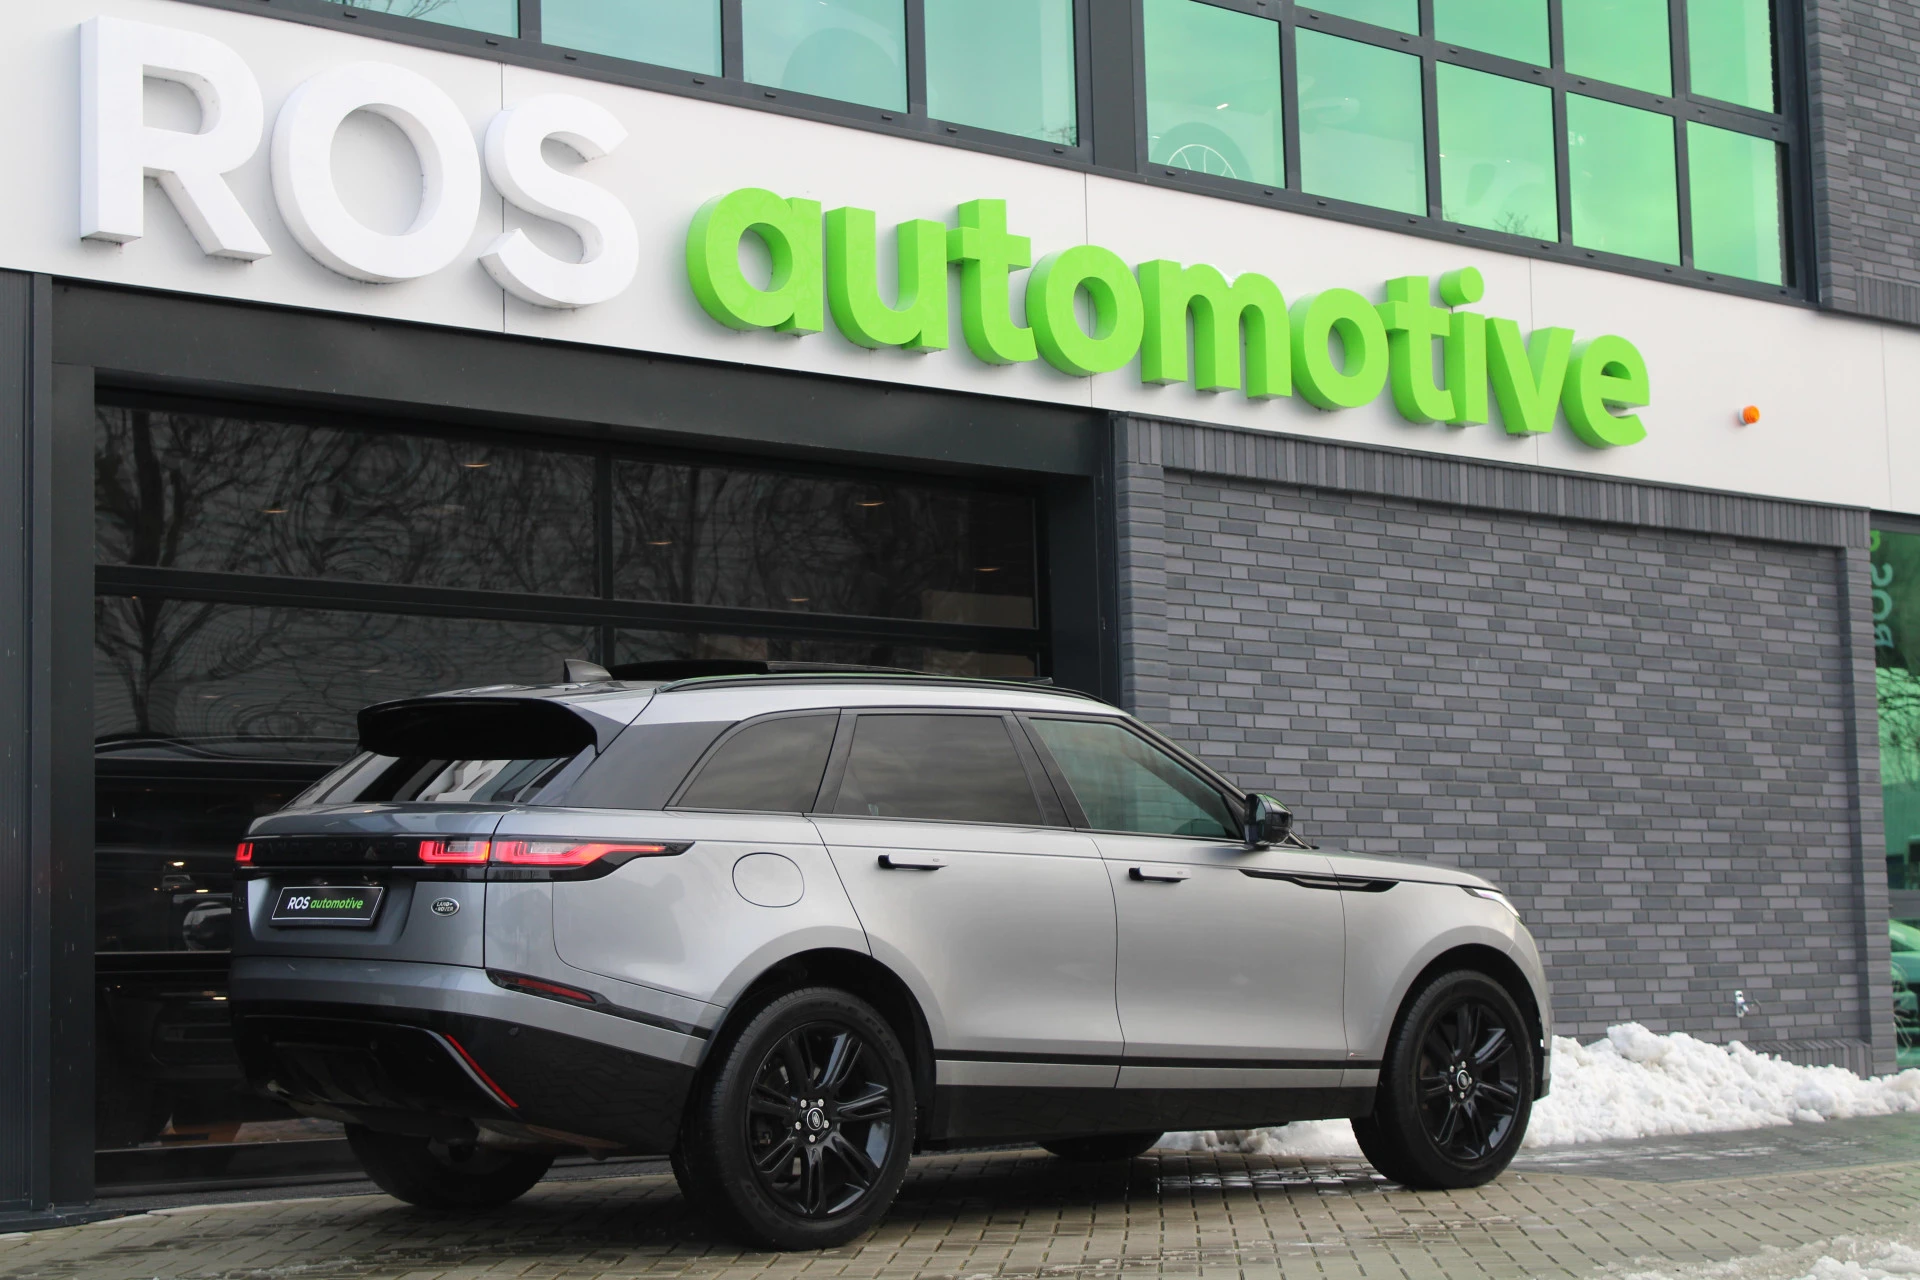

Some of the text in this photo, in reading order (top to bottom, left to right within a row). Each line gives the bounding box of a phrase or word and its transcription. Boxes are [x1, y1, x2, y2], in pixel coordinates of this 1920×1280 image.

[80, 16, 1650, 448] ROS automotive
[286, 896, 364, 910] ROS automotive
